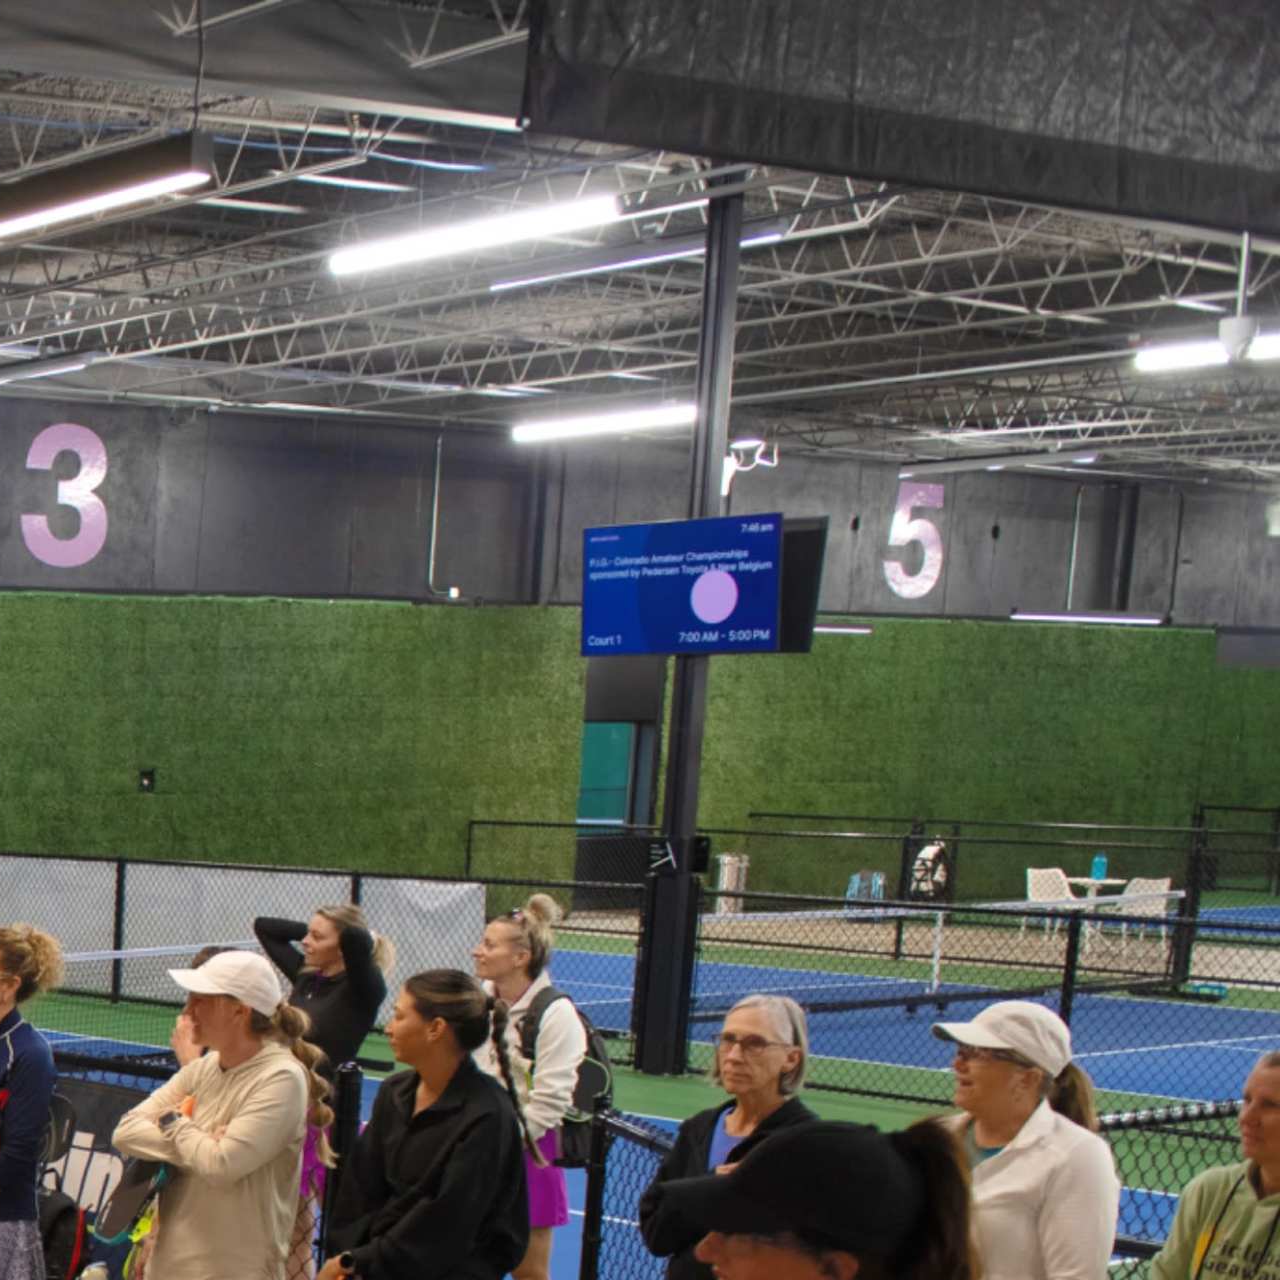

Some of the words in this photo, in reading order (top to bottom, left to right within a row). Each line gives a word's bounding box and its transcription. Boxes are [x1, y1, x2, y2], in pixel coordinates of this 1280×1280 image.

[21, 421, 109, 569] 3
[759, 523, 774, 533] am
[883, 481, 945, 600] 5
[614, 555, 649, 566] Colorado
[651, 552, 684, 564] Amateur
[686, 549, 749, 563] Championships
[589, 570, 629, 582] sponsored
[630, 569, 641, 580] by
[587, 635, 615, 646] Court
[679, 632, 701, 643] 7:00
[702, 631, 719, 642] AM
[728, 630, 750, 641] 5:00
[752, 629, 770, 640] PM
